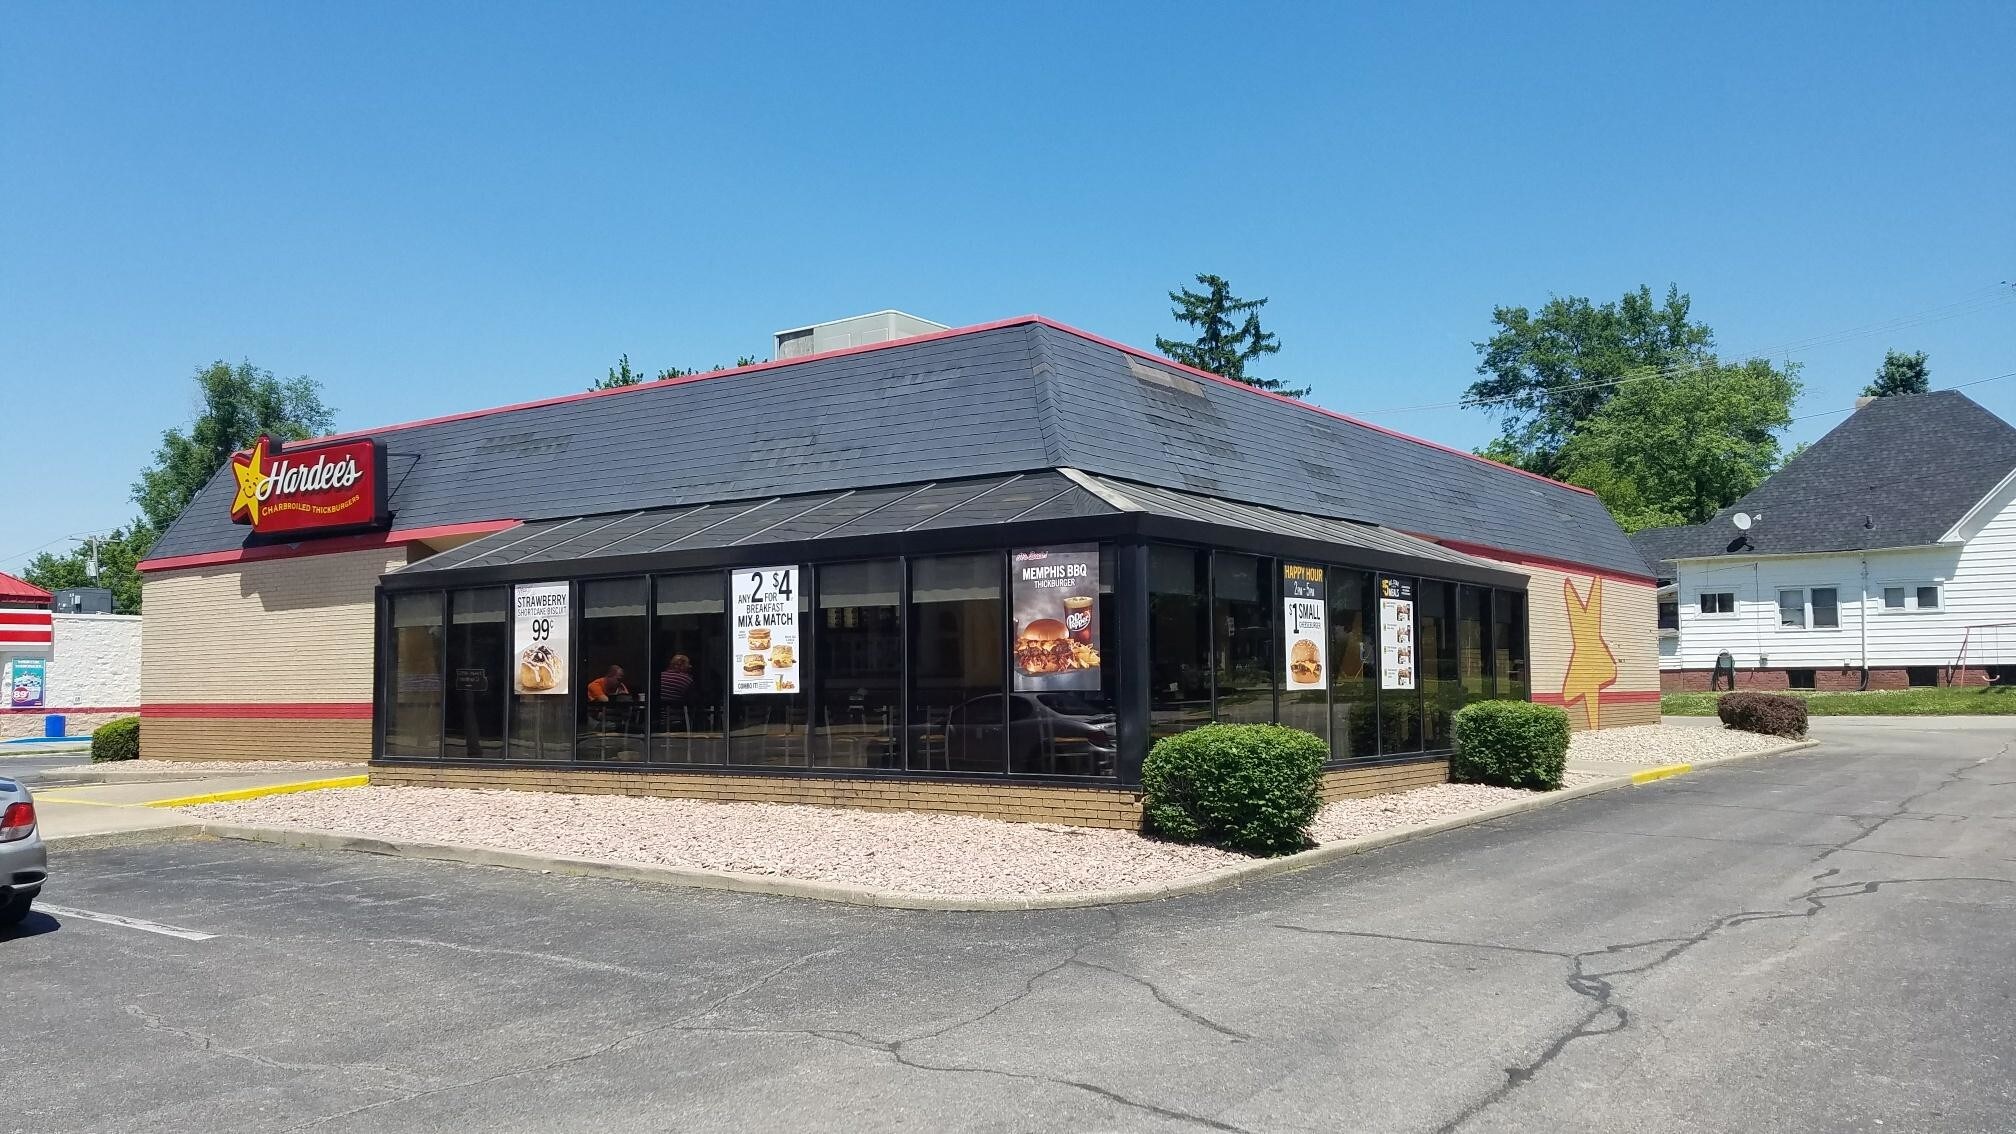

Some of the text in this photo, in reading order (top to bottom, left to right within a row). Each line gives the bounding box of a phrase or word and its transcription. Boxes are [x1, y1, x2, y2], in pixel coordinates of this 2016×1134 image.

[256, 454, 363, 501] Hardee's
[262, 495, 360, 517] CHARBROILED THICKBURGERS
[1023, 564, 1087, 580] MEMPHIS BBQ
[1284, 564, 1323, 582] HAPPY HOUR
[738, 569, 793, 604] ANY 2 FOR $4
[1034, 578, 1076, 589] THICKBURGER
[518, 594, 566, 607] STRAWBERRY
[746, 603, 784, 614] BREAKFAST
[517, 607, 546, 617] SHORTCAKE
[1299, 603, 1320, 620] SMALL
[738, 613, 793, 628] MIX & MATCH
